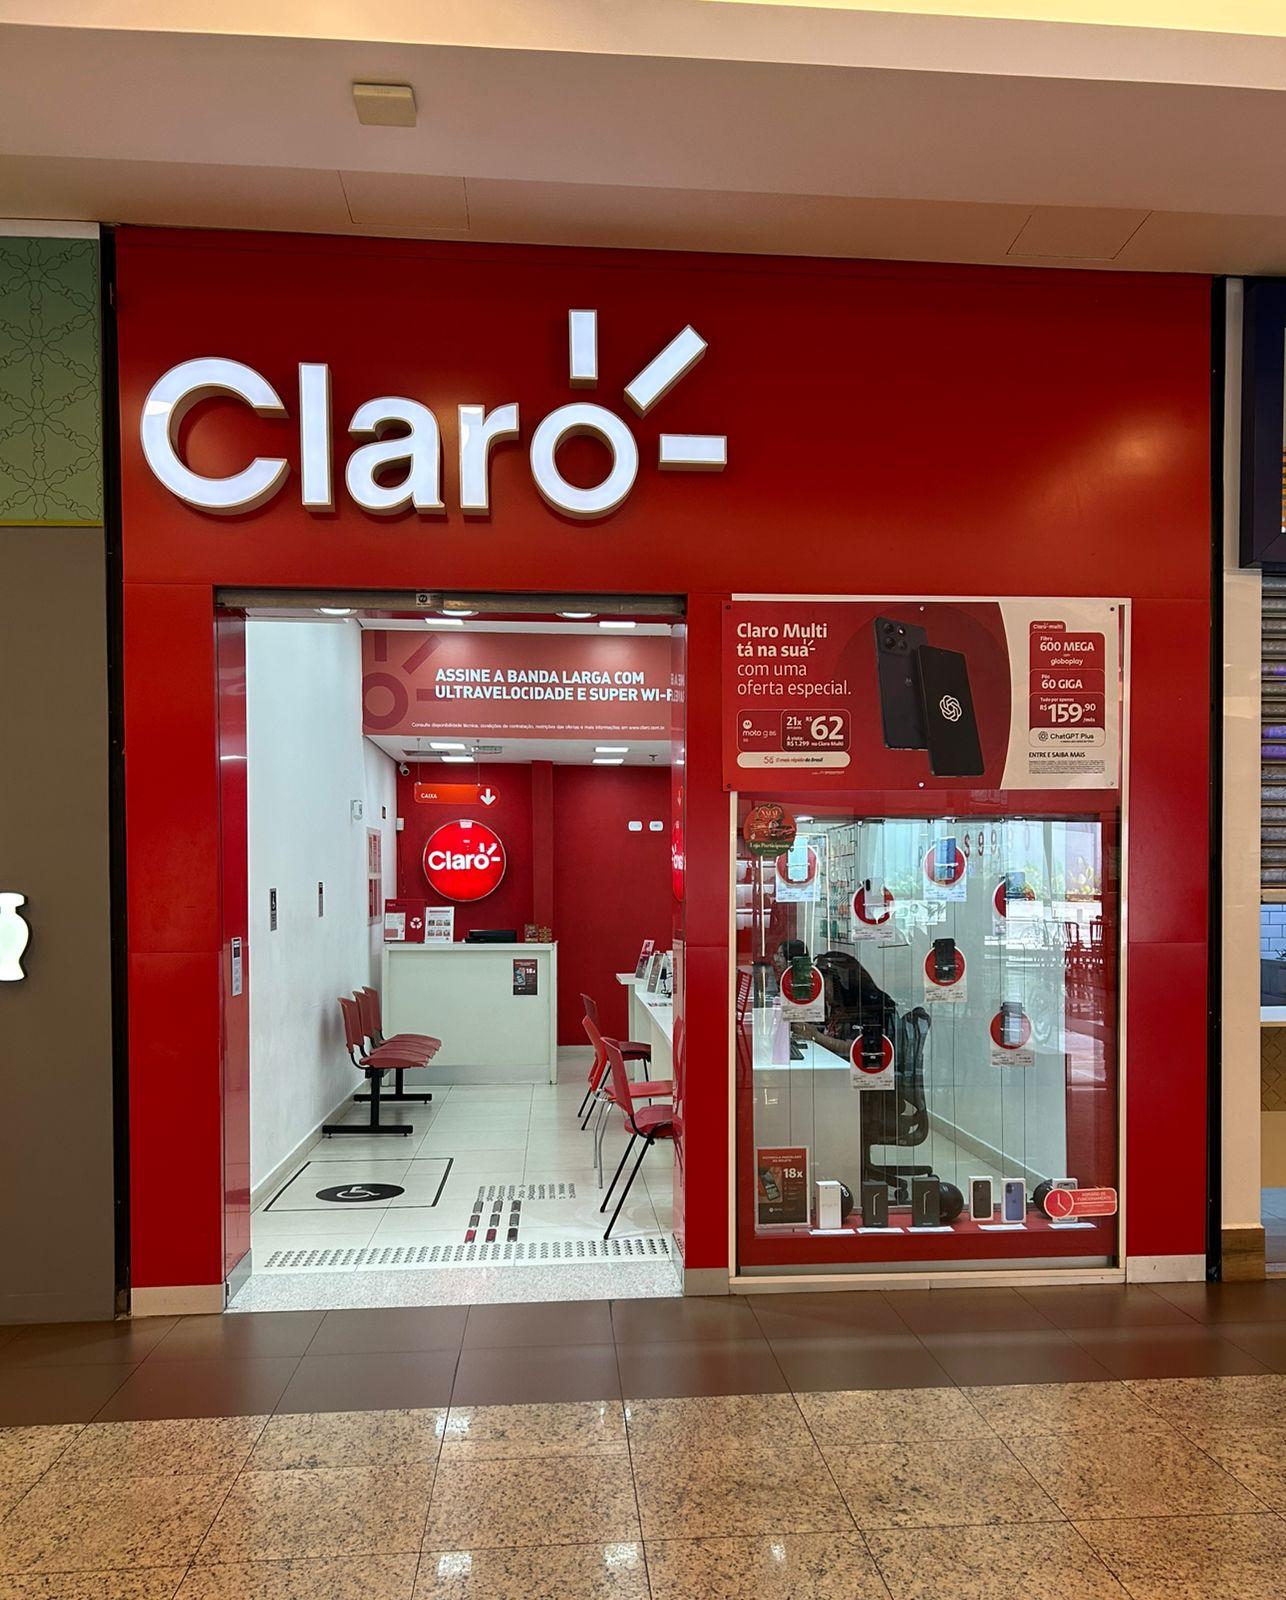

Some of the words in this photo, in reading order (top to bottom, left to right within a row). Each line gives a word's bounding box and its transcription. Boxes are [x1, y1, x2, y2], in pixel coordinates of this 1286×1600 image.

[140, 355, 641, 521] Claro
[737, 622, 779, 638] Claro
[783, 623, 828, 638] Multi
[736, 641, 754, 657] tá
[757, 646, 777, 657] na
[780, 643, 810, 657] sua
[1040, 642, 1061, 652] 600
[1064, 642, 1094, 652] MEGA
[737, 664, 769, 676] com
[774, 664, 807, 676] uma
[1051, 658, 1083, 666] globoplay
[435, 668, 490, 682] ASSINE
[493, 669, 504, 682] A
[507, 670, 559, 683] BANDA
[562, 670, 611, 684] LARGA
[614, 671, 644, 685] COM
[1042, 679, 1056, 689] 60
[1058, 679, 1083, 689] GIGA
[435, 685, 574, 700] ULTRAVELOCIDADE
[578, 688, 586, 700] E
[589, 688, 638, 701] SUPER
[737, 679, 783, 695] oferta
[788, 680, 851, 698] especial.
[786, 717, 802, 726] 21x
[811, 716, 844, 740] 62
[1050, 732, 1079, 740] ChatGPT
[428, 850, 490, 870] Claro
[783, 1168, 803, 1178] 18x
